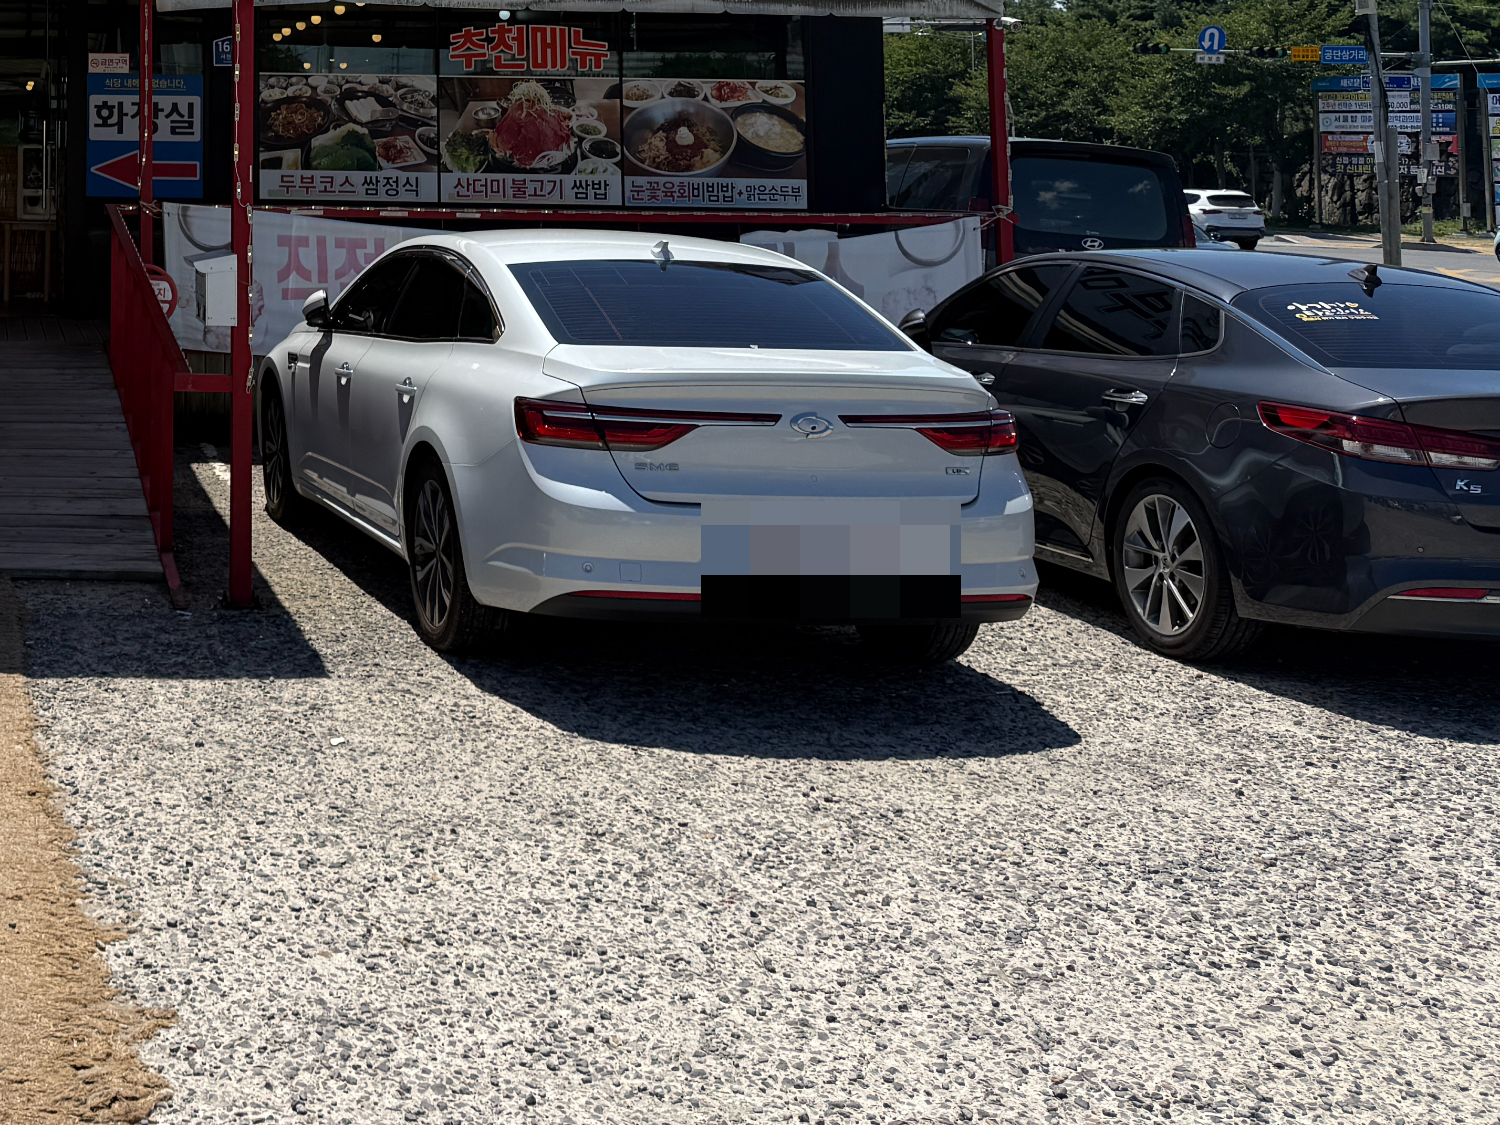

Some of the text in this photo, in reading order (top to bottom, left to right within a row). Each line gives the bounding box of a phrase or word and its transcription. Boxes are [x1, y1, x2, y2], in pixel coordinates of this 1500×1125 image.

[449, 22, 609, 72] 추천메뉴
[1324, 49, 1366, 61] 공단삼거리
[105, 78, 121, 88] 식당
[124, 78, 140, 88] 내에
[277, 174, 420, 198] 두부코스 쌈정식
[570, 179, 610, 201] 쌈밥
[634, 462, 680, 472] SM6
[1455, 478, 1482, 494] K5
